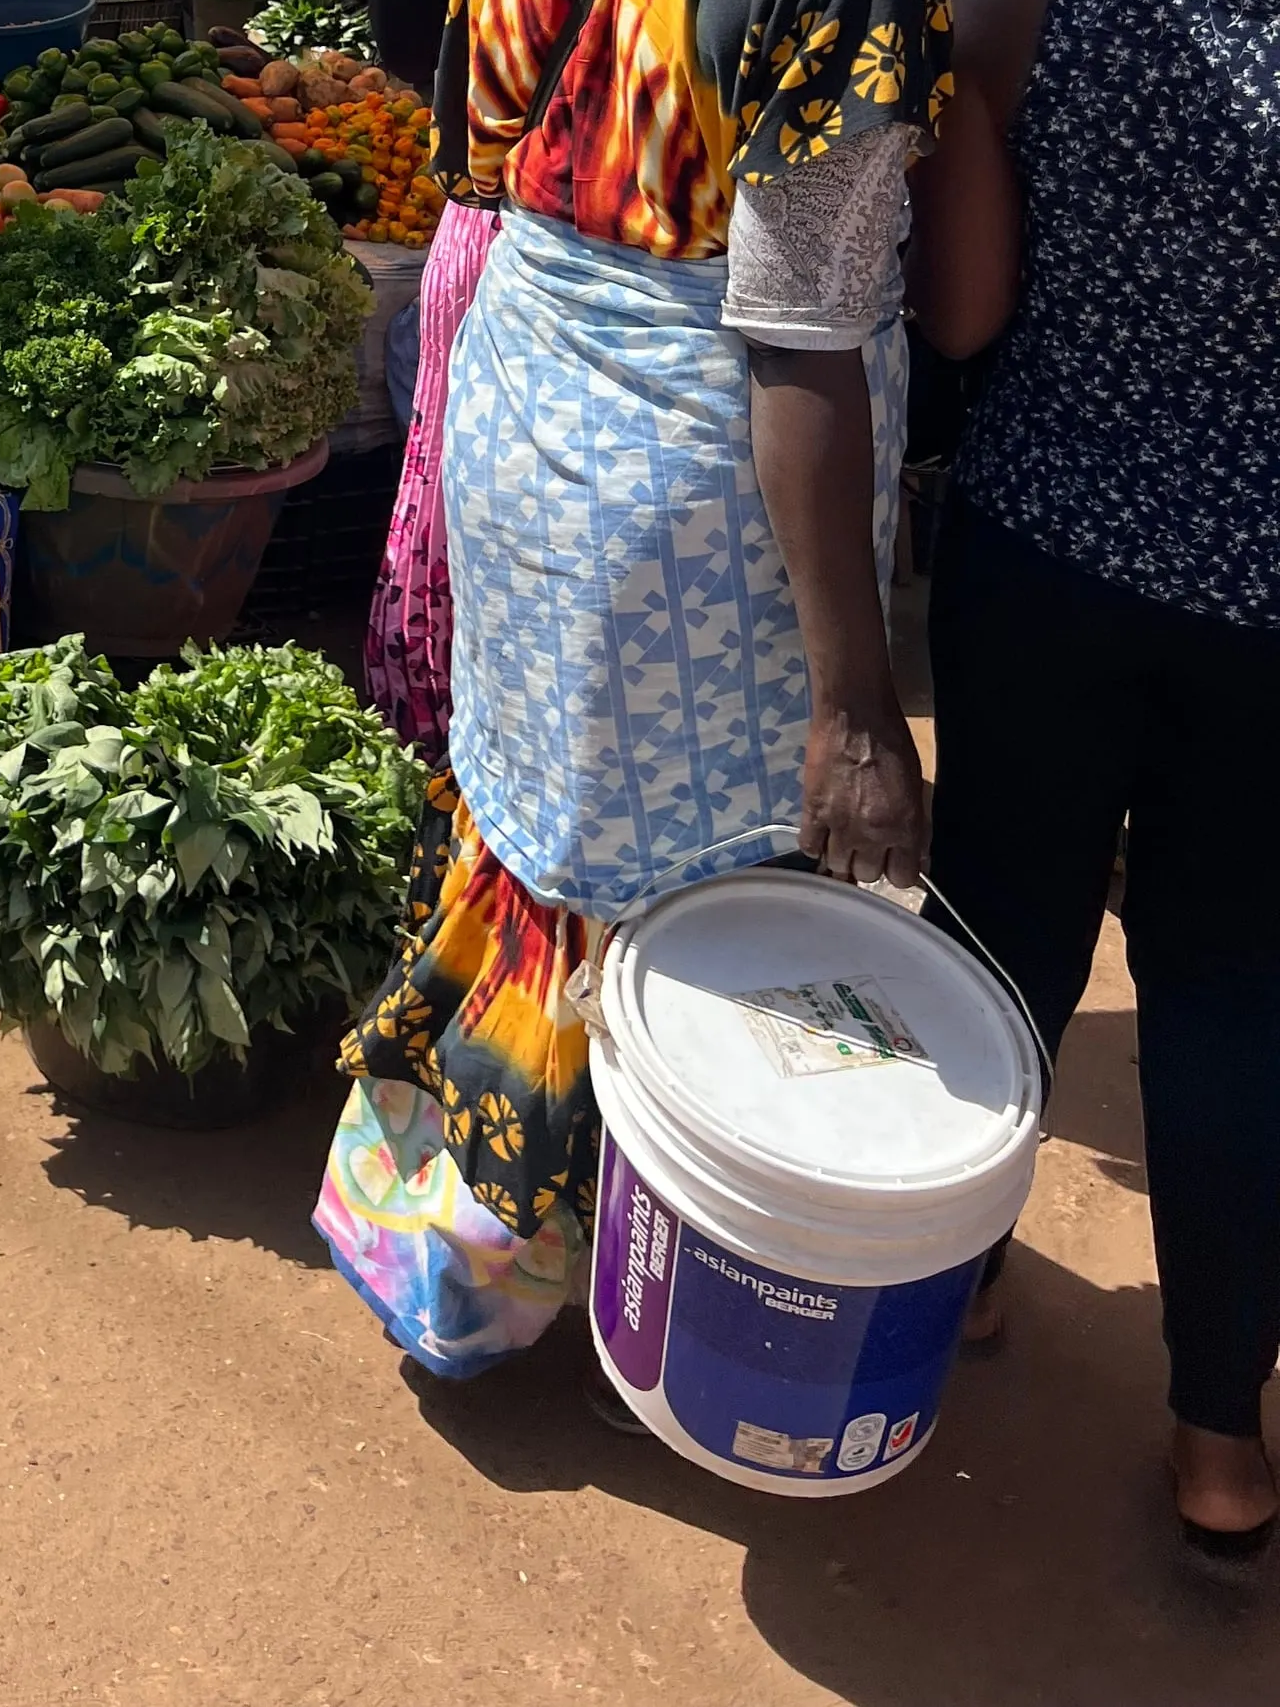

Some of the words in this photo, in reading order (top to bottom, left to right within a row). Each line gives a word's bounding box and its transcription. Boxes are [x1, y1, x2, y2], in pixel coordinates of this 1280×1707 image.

[622, 1184, 656, 1332] asianpaints
[649, 1209, 670, 1281] BERGER
[693, 1246, 838, 1310] asianpaints
[765, 1297, 836, 1321] BERGER
